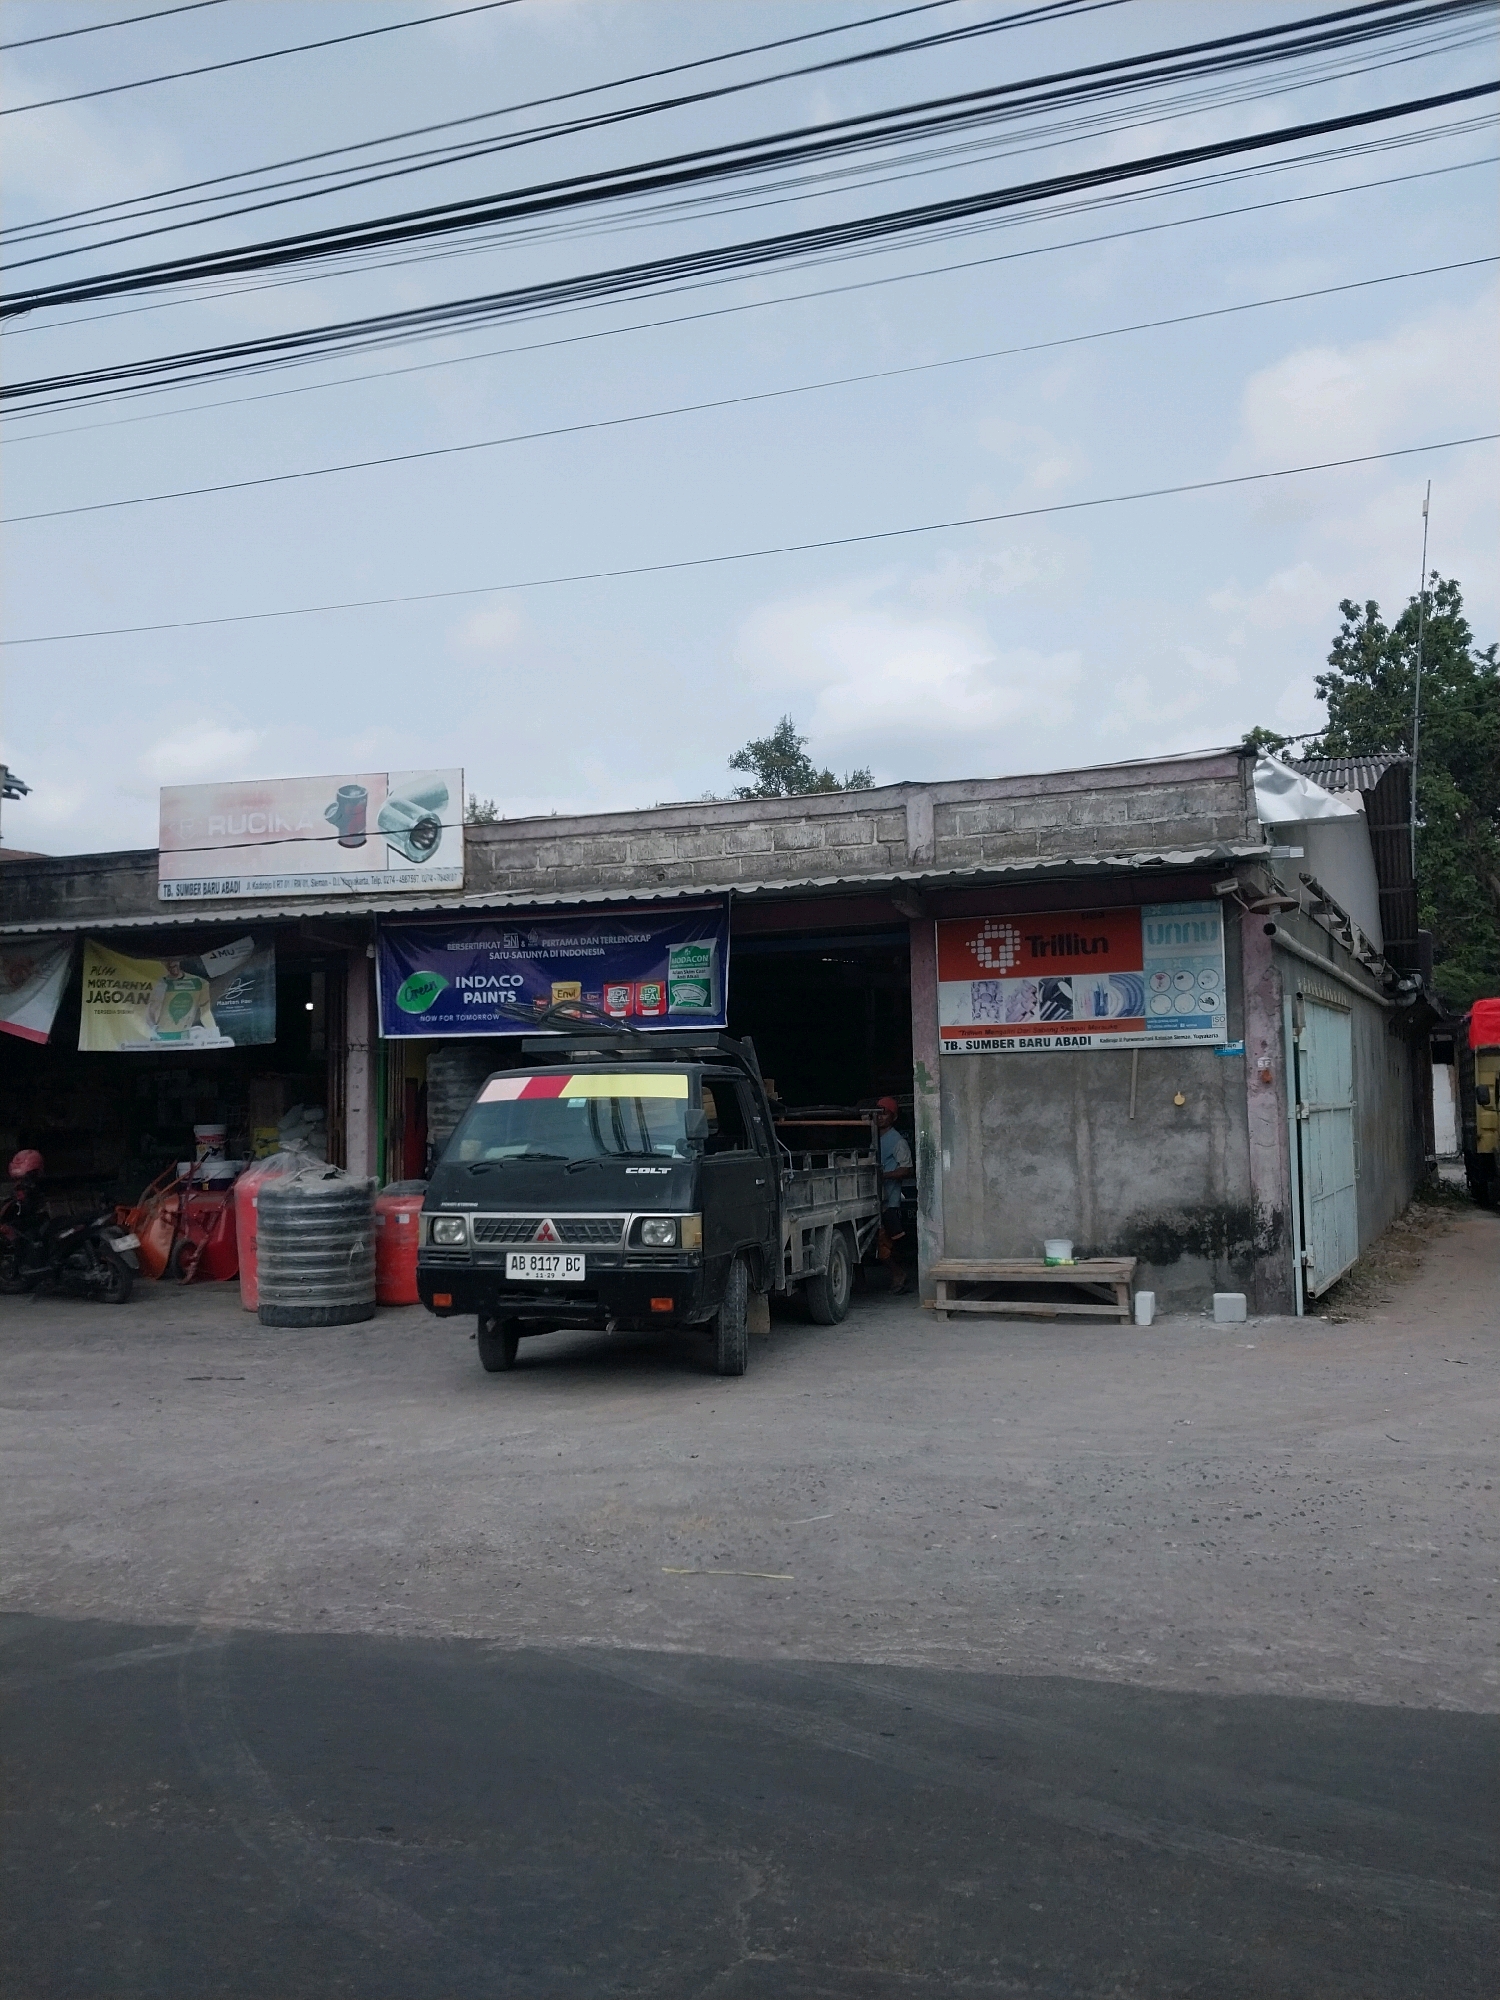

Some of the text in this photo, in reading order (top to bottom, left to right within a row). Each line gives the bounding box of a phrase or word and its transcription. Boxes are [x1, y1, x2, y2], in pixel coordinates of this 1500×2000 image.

[208, 811, 314, 836] RUCIKA
[176, 883, 202, 896] SUMBER
[203, 882, 220, 895] BARU
[221, 881, 241, 894] ABADI
[447, 940, 501, 951] BERSERTIFIKAT
[542, 938, 579, 947] PERTAMA
[580, 936, 599, 946] DAN
[600, 934, 652, 945] TERLENGKAP
[489, 948, 605, 960] SATU-SATUNYA DI INDONESIA
[87, 979, 153, 990] MORTARNYA
[456, 974, 524, 989] INDACO
[86, 990, 150, 1005] JAGOAN
[404, 980, 439, 1003] Green
[464, 990, 518, 1004] PAINTS
[640, 993, 663, 1001] SEAL
[644, 986, 658, 995] TOP
[420, 1014, 438, 1022] NOW
[456, 1013, 501, 1021] TOMORROW
[944, 1036, 1092, 1050] TB. SUMBER BARU ABADI
[625, 1167, 672, 1175] COLT
[511, 1255, 581, 1271] AB 8117 BC
